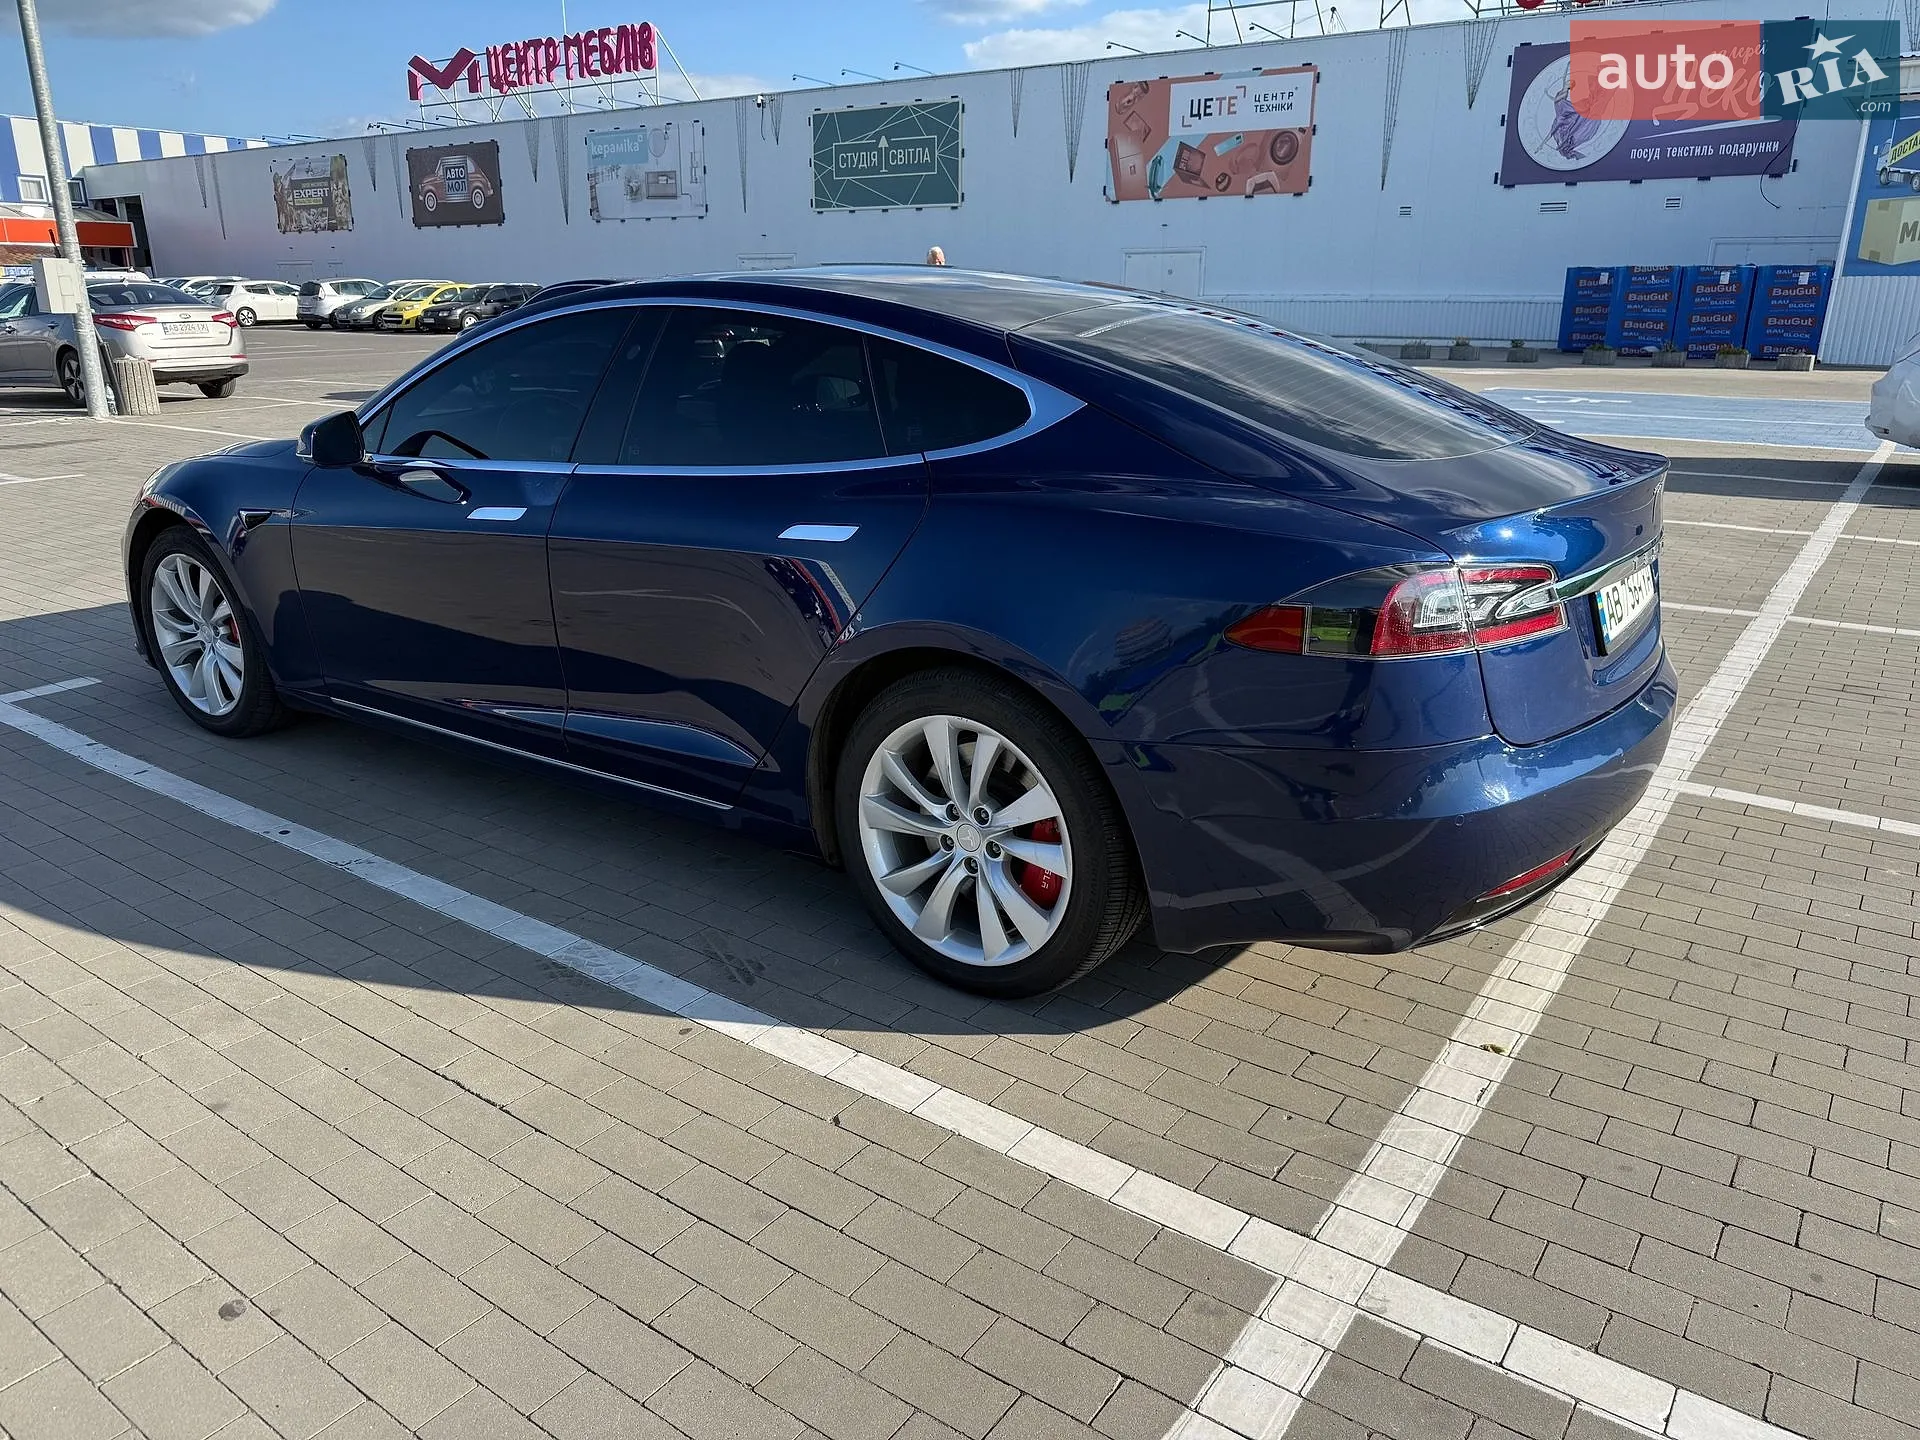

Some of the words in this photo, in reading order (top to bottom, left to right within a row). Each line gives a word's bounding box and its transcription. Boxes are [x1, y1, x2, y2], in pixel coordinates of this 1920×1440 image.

[486, 36, 561, 94] ЦЕНТР
[563, 21, 658, 80] МЕБЛІВ
[1254, 91, 1294, 103] ЦЕНТР
[1189, 96, 1238, 120] ЦЕТЕ
[1254, 102, 1293, 113] ТЕХНІКИ
[1630, 147, 1660, 162] посуд
[1666, 144, 1714, 158] текстиль
[1719, 141, 1779, 157] подарунки
[839, 151, 878, 169] СТУДІЯ
[889, 147, 931, 165] СВІТЛА
[446, 168, 465, 179] АВТО
[447, 181, 467, 193] МОЛ
[293, 188, 330, 198] EXPERT
[1696, 284, 1737, 293] BauGut
[1772, 286, 1817, 296] BauGut
[1628, 292, 1668, 301] BauGut
[1575, 306, 1608, 314] BauGu
[1692, 314, 1733, 323] BauGut
[1767, 317, 1813, 326] BauGut
[1624, 320, 1664, 330] BauGut
[1572, 333, 1605, 341] BauGu
[1606, 586, 1623, 631] AB
